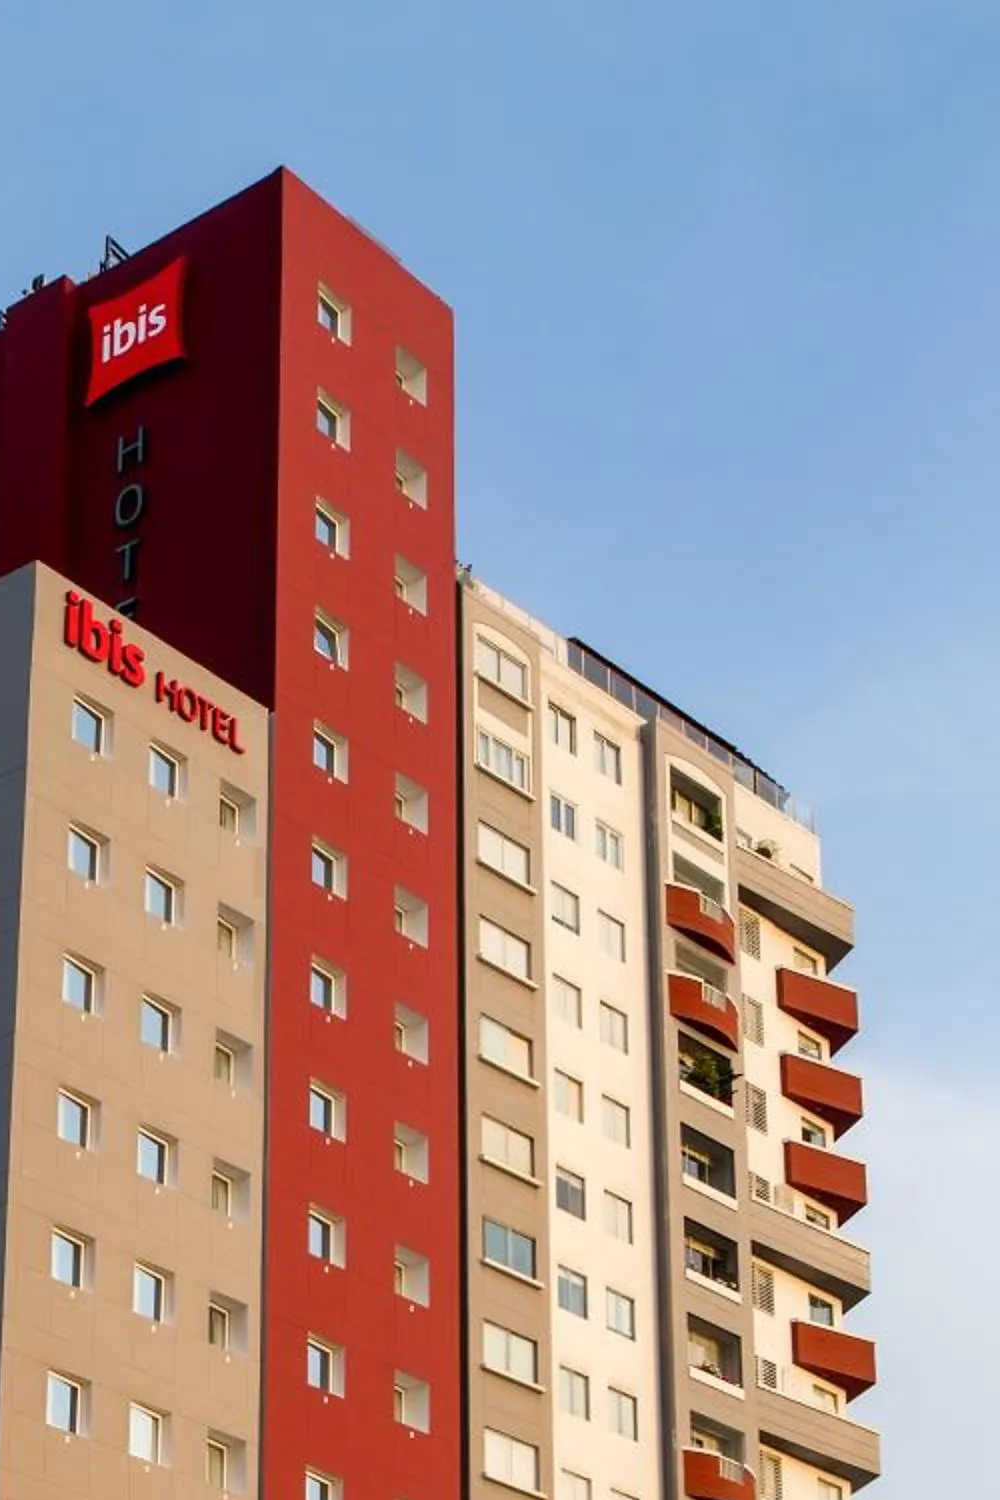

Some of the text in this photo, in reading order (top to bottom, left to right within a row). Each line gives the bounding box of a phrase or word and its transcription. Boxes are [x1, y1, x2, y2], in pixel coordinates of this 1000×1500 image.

[102, 303, 167, 363] ibis
[64, 590, 246, 755] ibis HOTEL
